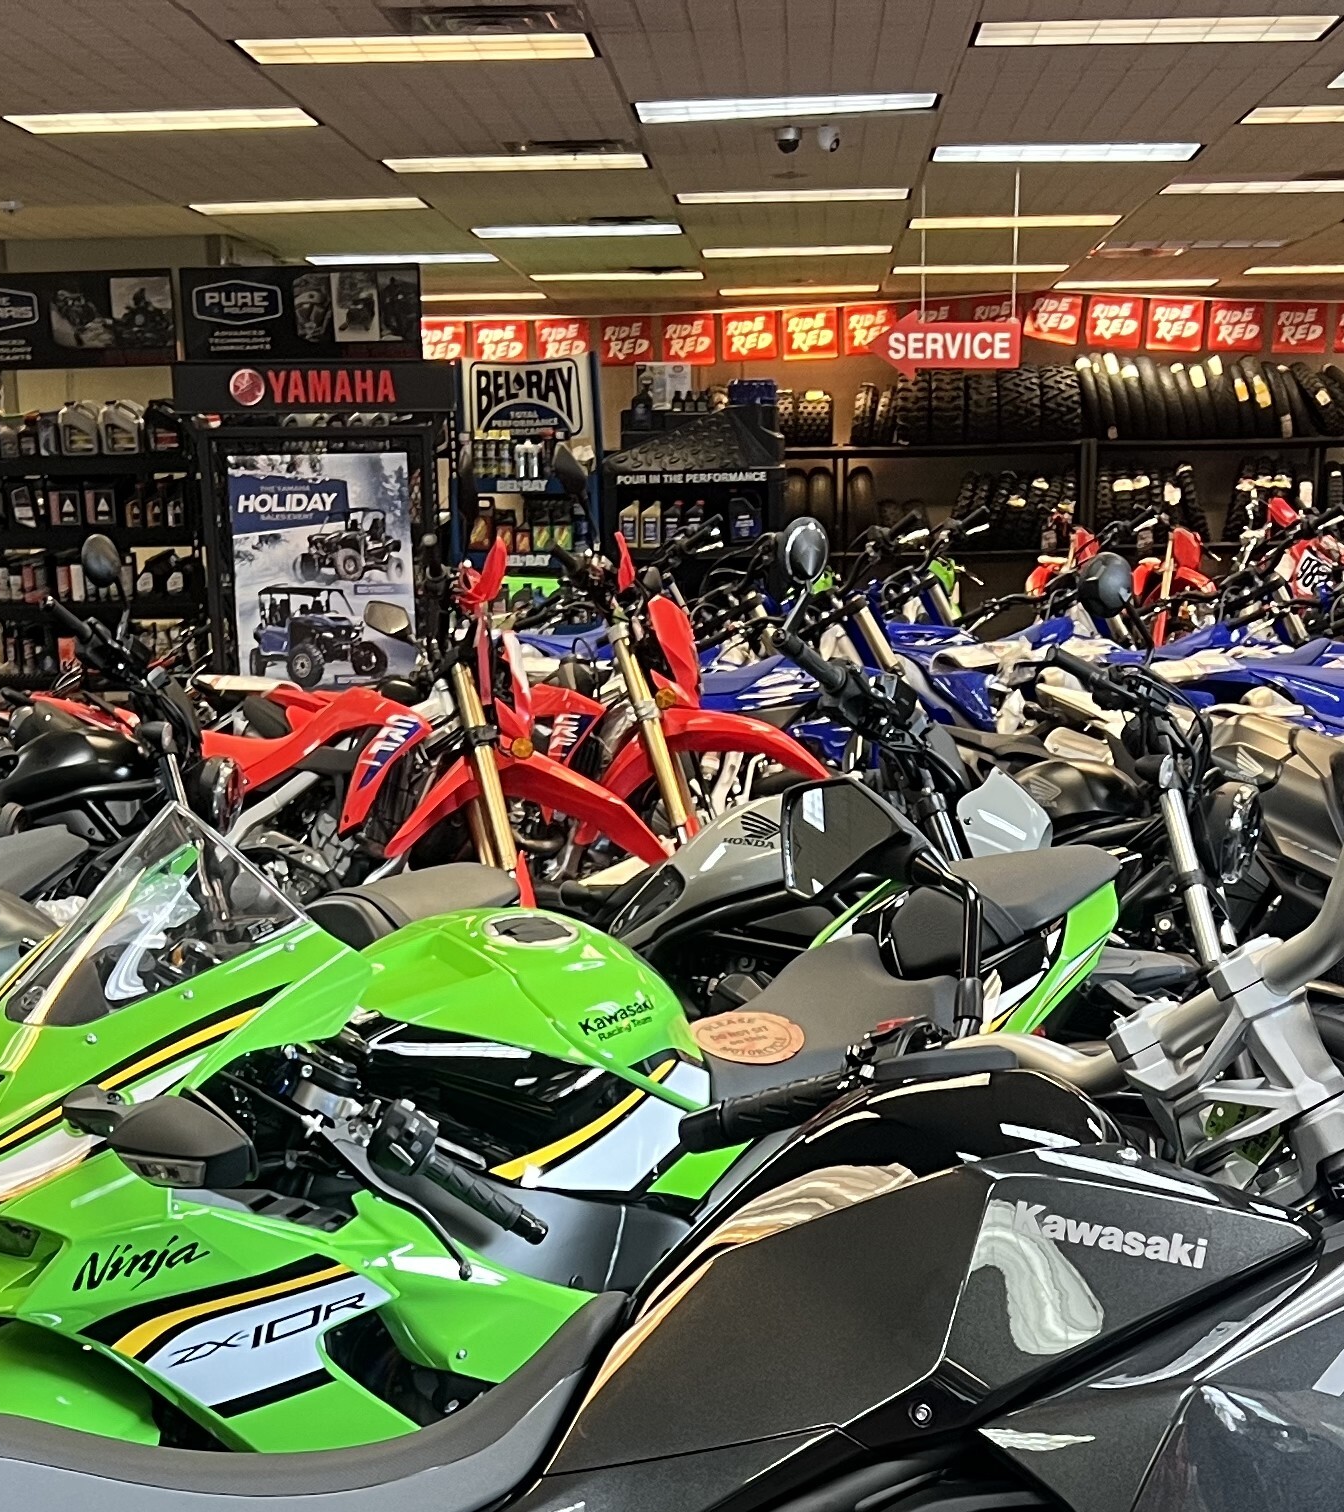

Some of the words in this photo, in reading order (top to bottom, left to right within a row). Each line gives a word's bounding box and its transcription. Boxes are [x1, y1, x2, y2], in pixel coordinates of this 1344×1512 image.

[204, 291, 270, 307] PURE
[1032, 297, 1073, 314] RIDE
[848, 310, 888, 330] RIDE
[1091, 302, 1133, 319] RIDE
[1153, 304, 1195, 322] RIDE
[1213, 307, 1255, 325] RIDE
[1277, 308, 1319, 326] RIDE
[604, 322, 642, 341] RIDE
[665, 320, 704, 340] RIDE
[726, 316, 766, 336] RIDE
[787, 313, 827, 333] RIDE
[1034, 312, 1076, 333] RED
[1094, 318, 1139, 340] RED
[1155, 320, 1201, 342] RED
[477, 326, 516, 343] RIDE
[540, 324, 579, 343] RIDE
[791, 329, 834, 352] RED
[1216, 323, 1260, 345] RED
[1280, 323, 1324, 345] RED
[482, 342, 523, 361] RED
[544, 340, 586, 360] RED
[608, 338, 650, 360] RED
[670, 336, 711, 358] RED
[731, 333, 773, 355] RED
[887, 331, 1011, 361] SERVICE
[267, 369, 397, 404] YAMAHA
[616, 475, 647, 485] POUR
[649, 474, 660, 484] IN
[662, 473, 683, 483] THE
[685, 471, 767, 483] PERFORMANCE
[237, 493, 338, 513] HOLIDAY
[722, 837, 775, 849] HONDA
[578, 994, 656, 1036] Kawasaki
[704, 1017, 756, 1032] PLEASE
[598, 1019, 632, 1042] Racing
[632, 1015, 654, 1029] Team
[1014, 1199, 1210, 1270] Kawasaki
[72, 1234, 211, 1291] Ninja
[168, 1291, 368, 1368] ZX-10R
